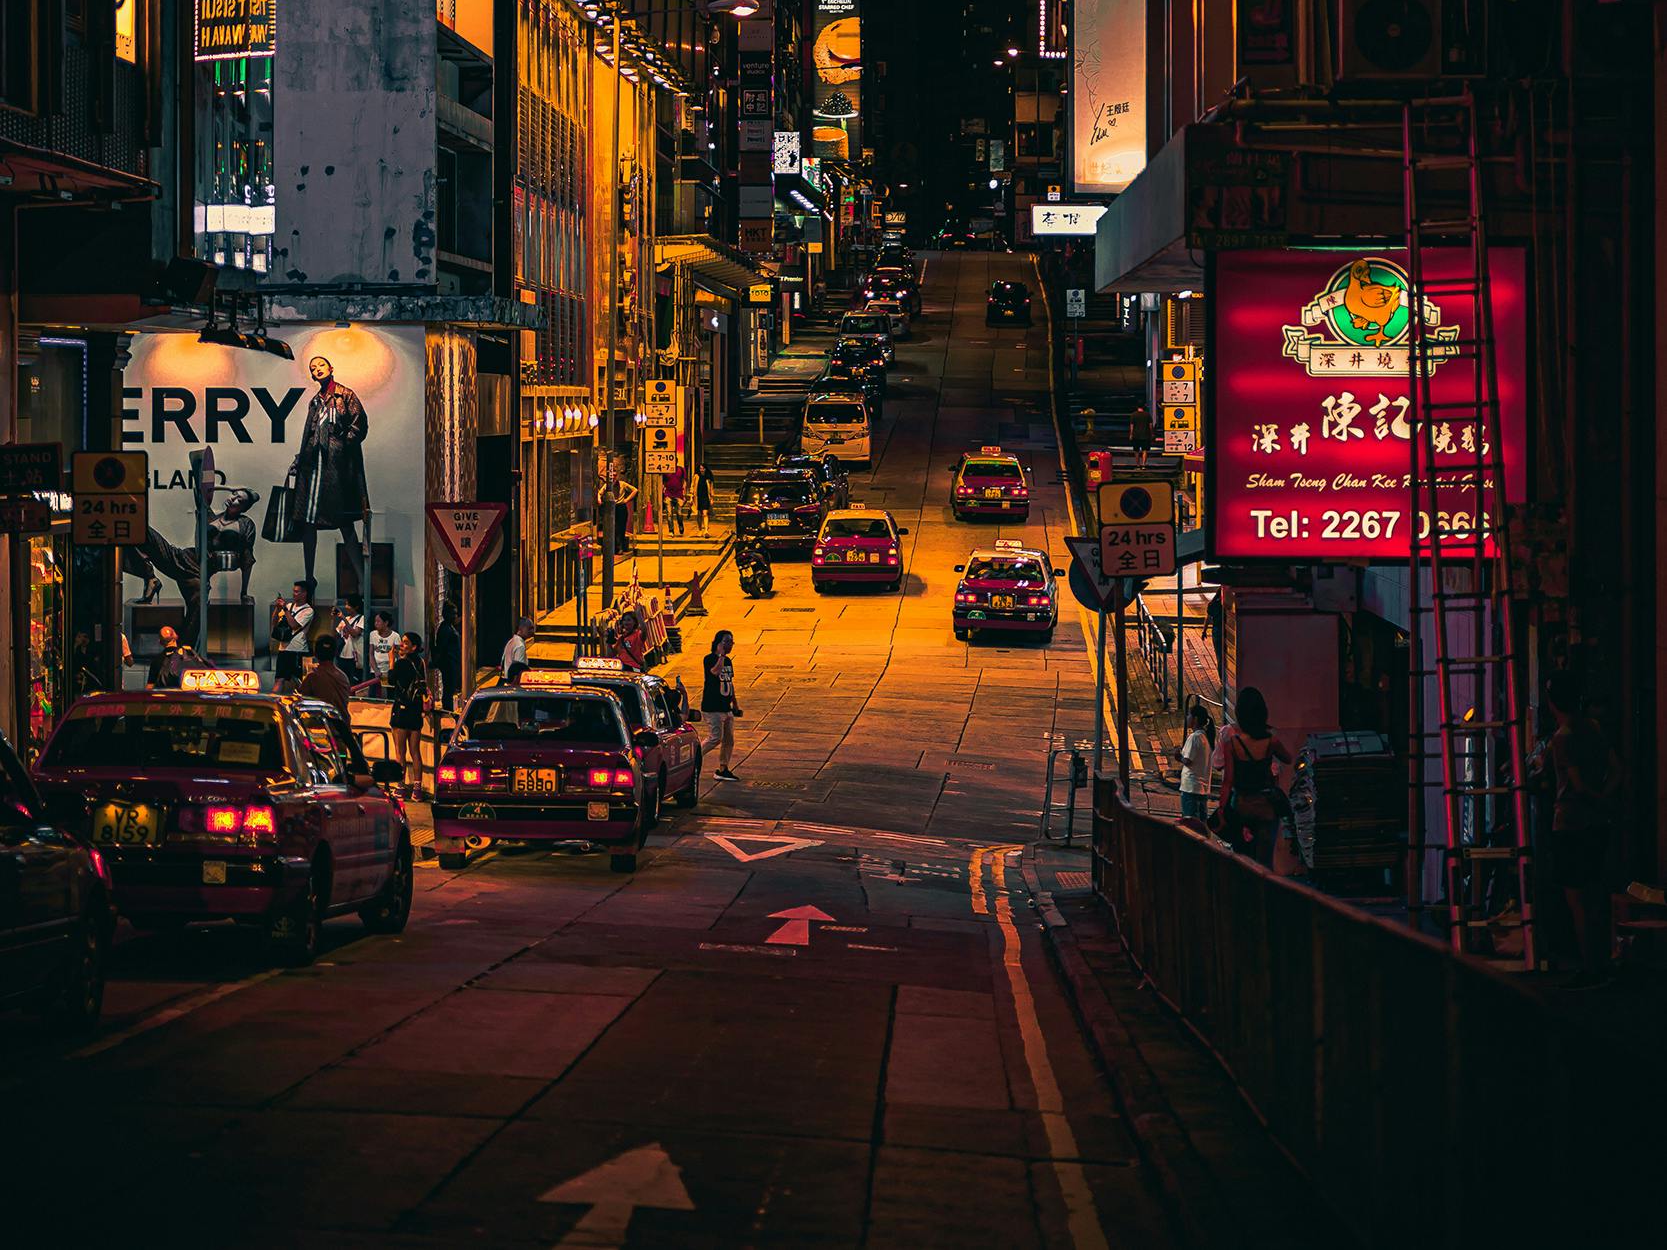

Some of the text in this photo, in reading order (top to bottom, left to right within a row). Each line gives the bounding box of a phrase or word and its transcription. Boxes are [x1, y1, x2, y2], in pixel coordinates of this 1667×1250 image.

[745, 228, 767, 237] HKT
[1183, 382, 1189, 390] 7
[1183, 393, 1189, 401] 7
[664, 405, 670, 413] 7
[665, 417, 675, 425] 12
[1184, 443, 1194, 451] 12
[1, 453, 52, 463] STAND
[656, 463, 671, 471] 4-7
[1246, 474, 1286, 490] Sham
[1290, 473, 1327, 492] Tseng
[1332, 473, 1367, 491] Chan
[1371, 474, 1397, 489] Kee
[81, 500, 138, 515] 24 hrs
[454, 512, 479, 521] GIVE
[87, 519, 131, 539] 全日
[455, 523, 478, 531] WAY
[1250, 510, 1309, 538] Tel:
[1321, 511, 1401, 539] 2267
[1108, 530, 1167, 546] 24 hrs
[1118, 549, 1161, 571] 全日
[190, 672, 250, 687] TAXI
[526, 769, 545, 780] KL
[517, 780, 554, 792] 5880
